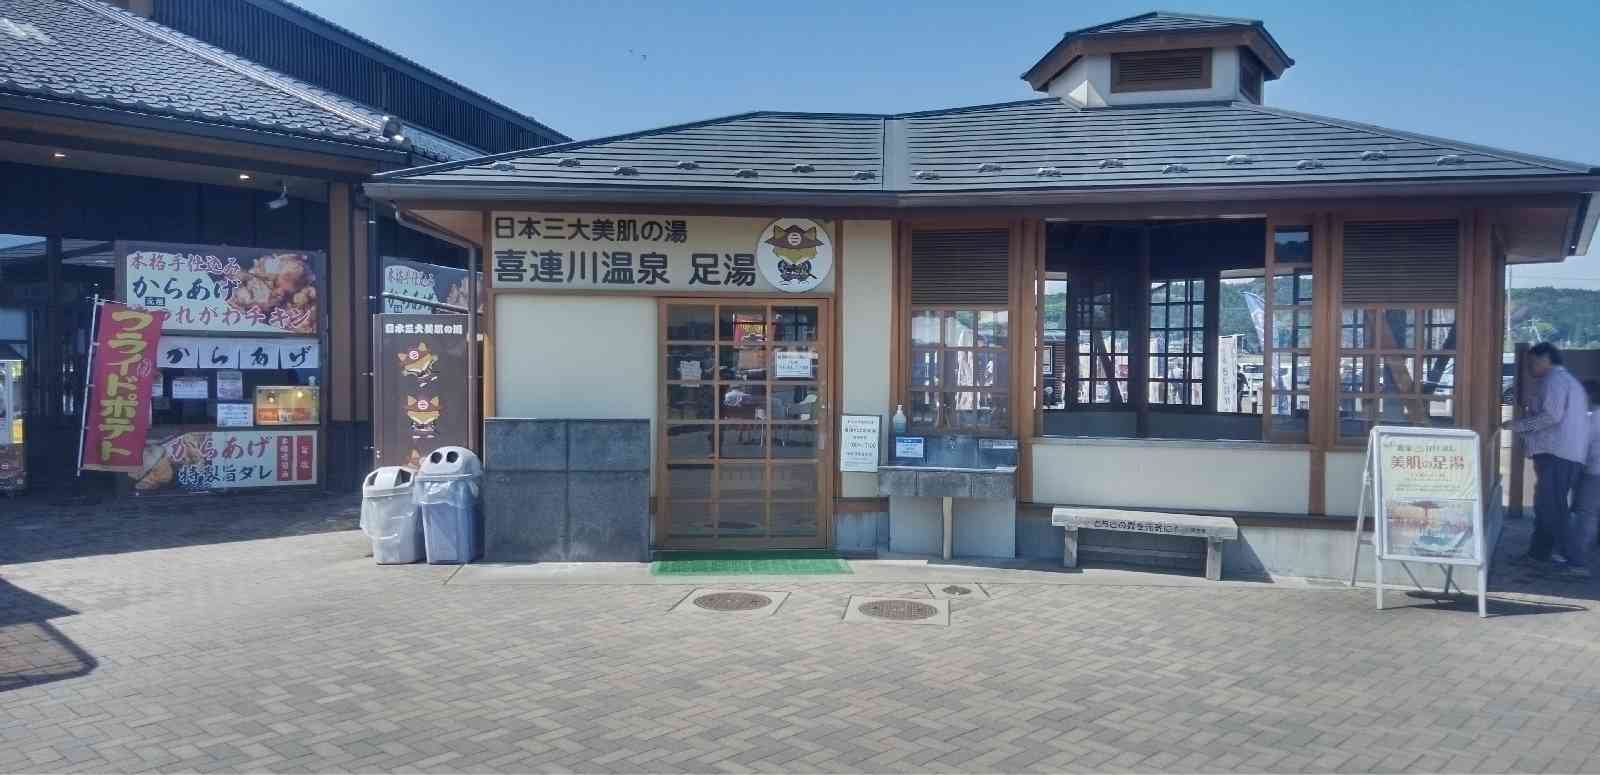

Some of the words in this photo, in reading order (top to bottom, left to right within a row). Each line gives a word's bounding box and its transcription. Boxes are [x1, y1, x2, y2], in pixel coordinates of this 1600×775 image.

[494, 216, 688, 243] 日本三大美肌の湯
[131, 253, 241, 275] 本格手仕込み
[494, 250, 670, 287] 喜連川温泉
[688, 252, 756, 287] 足湯
[132, 275, 241, 301] からあげ
[166, 345, 311, 368] からあげ
[98, 310, 153, 461] フライドポテト
[169, 435, 273, 462] からあげ
